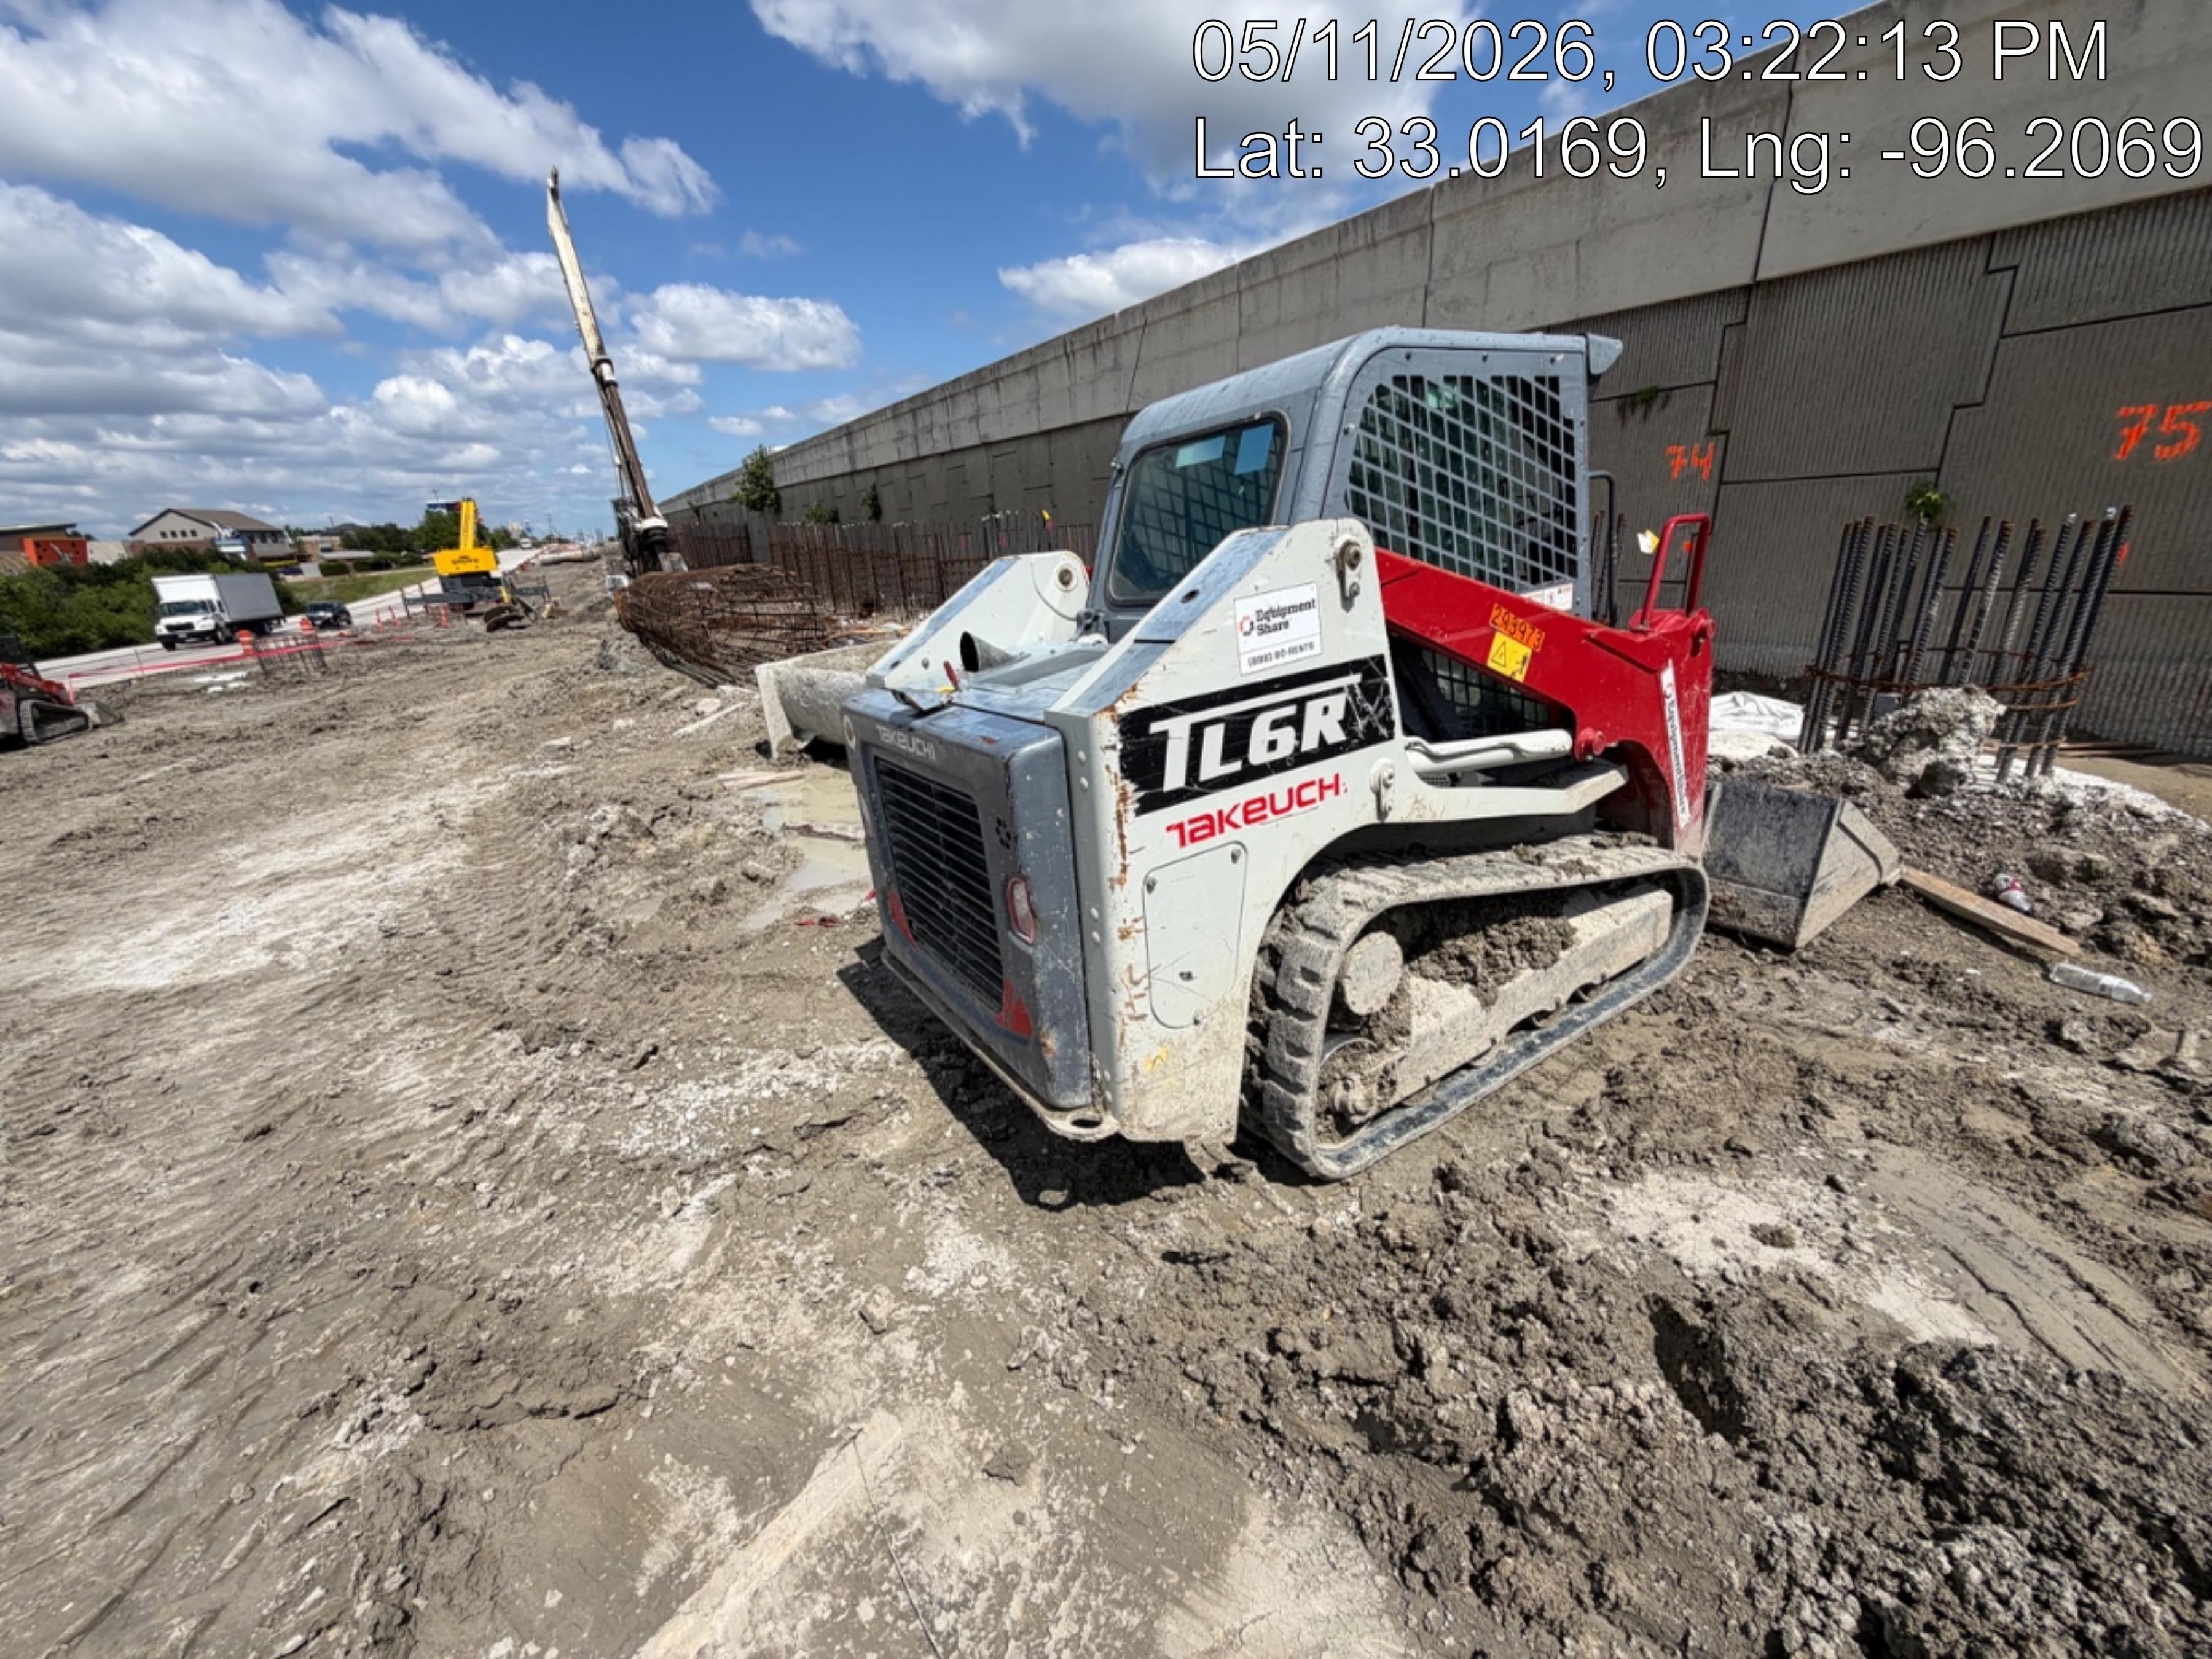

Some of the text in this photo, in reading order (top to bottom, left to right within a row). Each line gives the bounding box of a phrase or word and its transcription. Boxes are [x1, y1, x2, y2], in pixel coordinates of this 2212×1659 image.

[2116, 401, 2212, 460] 75
[1666, 442, 1715, 482] 74
[1255, 598, 1316, 622] Equipment
[1257, 620, 1290, 637] Share
[1149, 672, 1362, 793] TL6R
[1166, 772, 1348, 849] TAKEUCH
